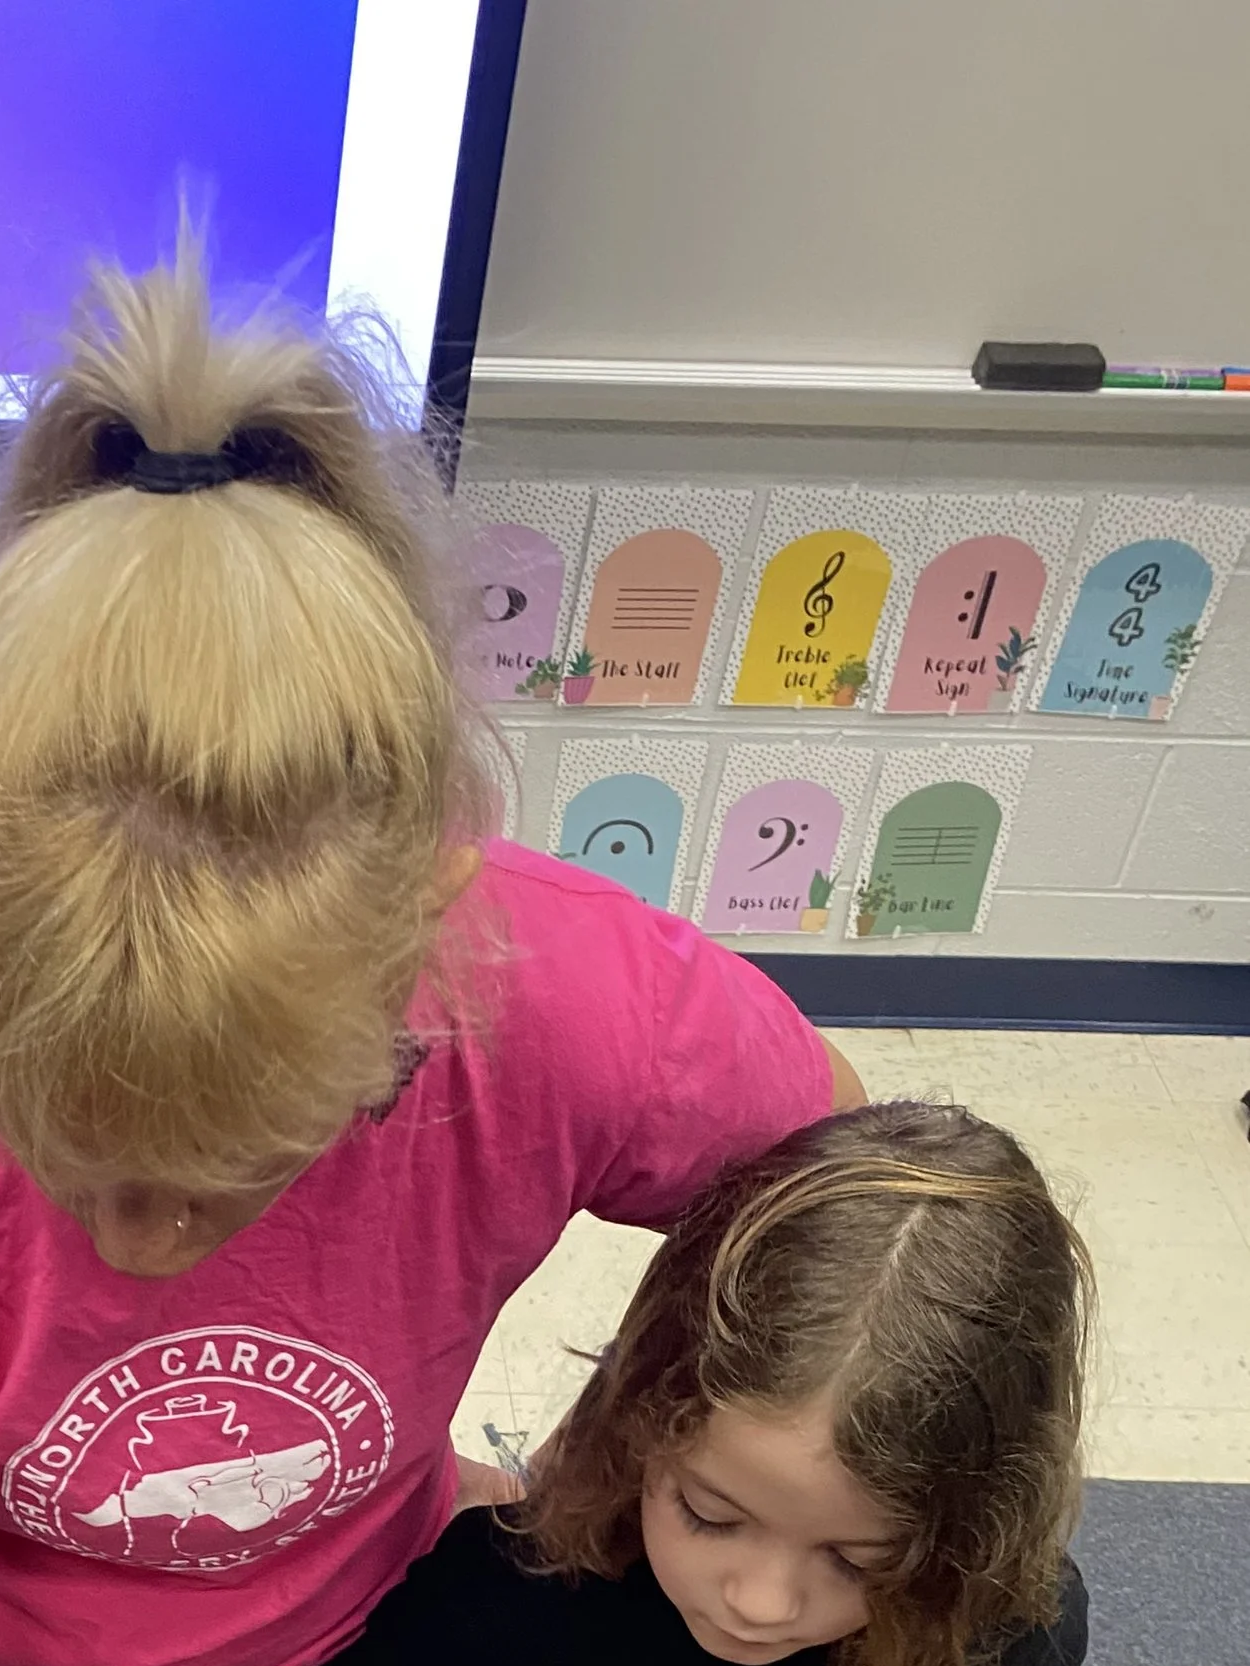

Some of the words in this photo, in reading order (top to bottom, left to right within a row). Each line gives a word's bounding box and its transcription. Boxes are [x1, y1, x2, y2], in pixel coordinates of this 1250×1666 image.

[1125, 562, 1161, 602] 4
[1108, 607, 1144, 647] 4
[496, 652, 536, 671] Note
[777, 645, 831, 664] Treble
[601, 659, 627, 678] The
[634, 660, 682, 679] Staff
[924, 656, 988, 678] Repeat
[1097, 659, 1135, 680] Time
[784, 671, 817, 689] Clef
[935, 680, 971, 700] Sign
[1063, 681, 1149, 705] Signature
[20, 1365, 141, 1489] NORTH
[160, 1340, 369, 1431] CAROLINA
